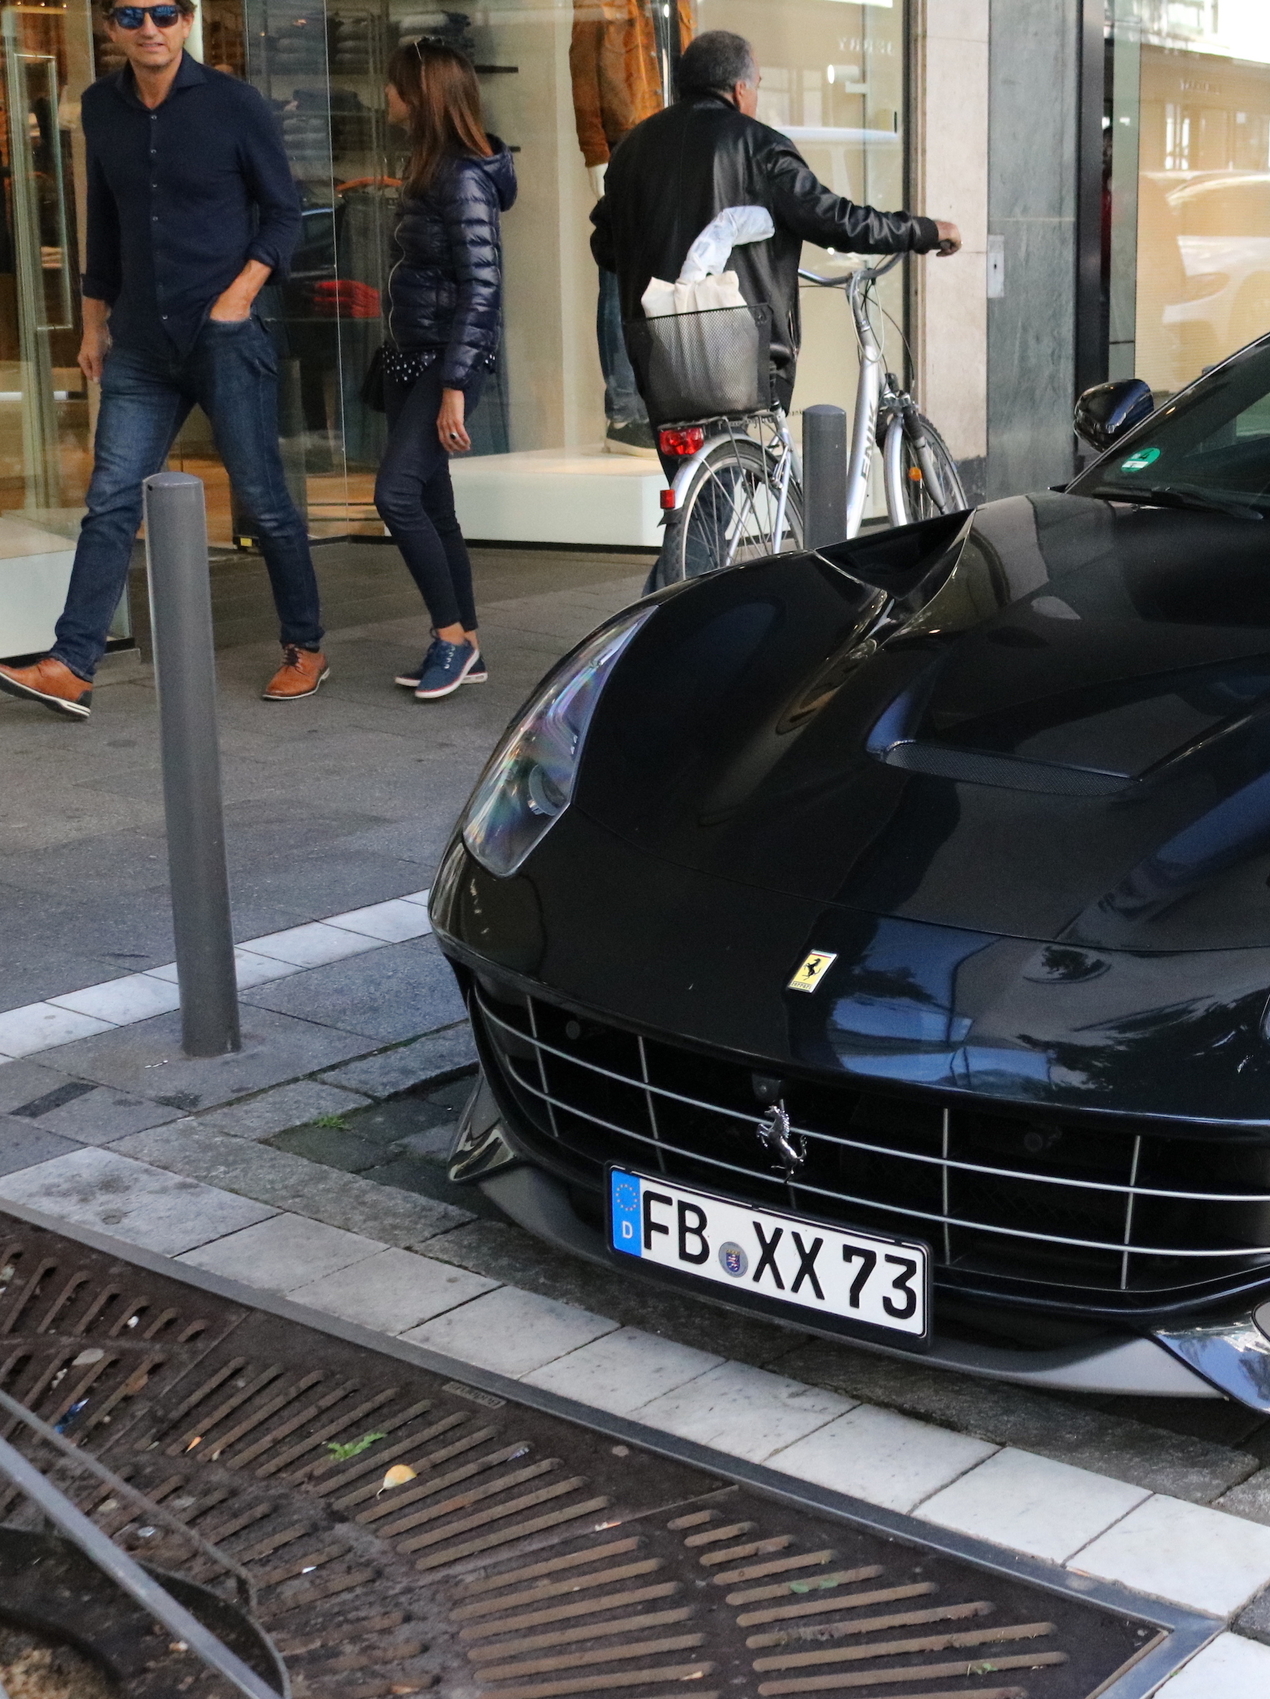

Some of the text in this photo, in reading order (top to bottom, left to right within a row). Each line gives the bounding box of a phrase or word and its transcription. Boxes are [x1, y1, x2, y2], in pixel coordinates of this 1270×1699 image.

[622, 1221, 633, 1239] D
[643, 1190, 917, 1320] FB XX 73
